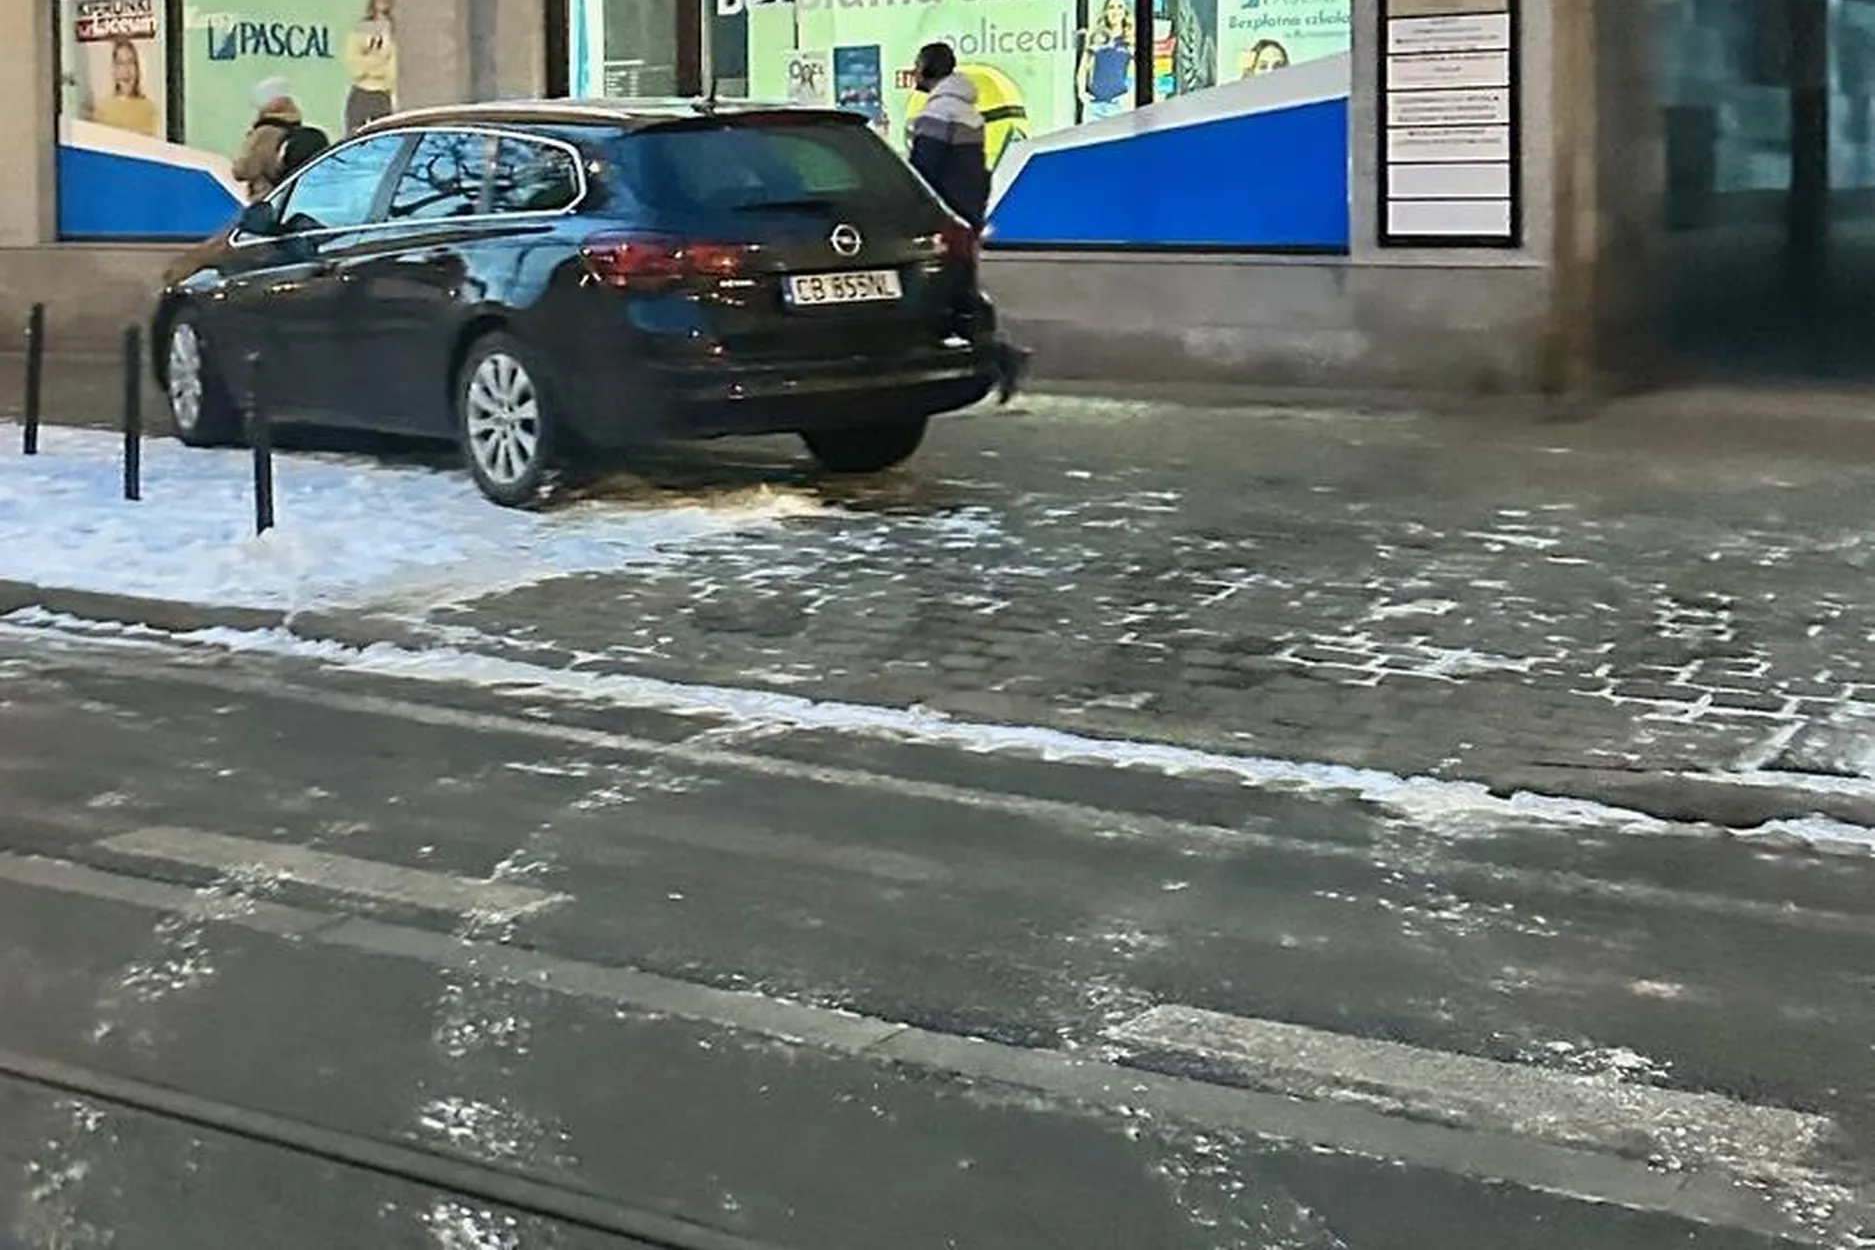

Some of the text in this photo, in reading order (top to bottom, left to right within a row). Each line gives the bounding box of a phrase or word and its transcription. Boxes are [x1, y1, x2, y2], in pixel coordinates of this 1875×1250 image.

[240, 21, 333, 58] PASCAL
[936, 12, 1110, 55] oliceala
[796, 278, 825, 302] CB
